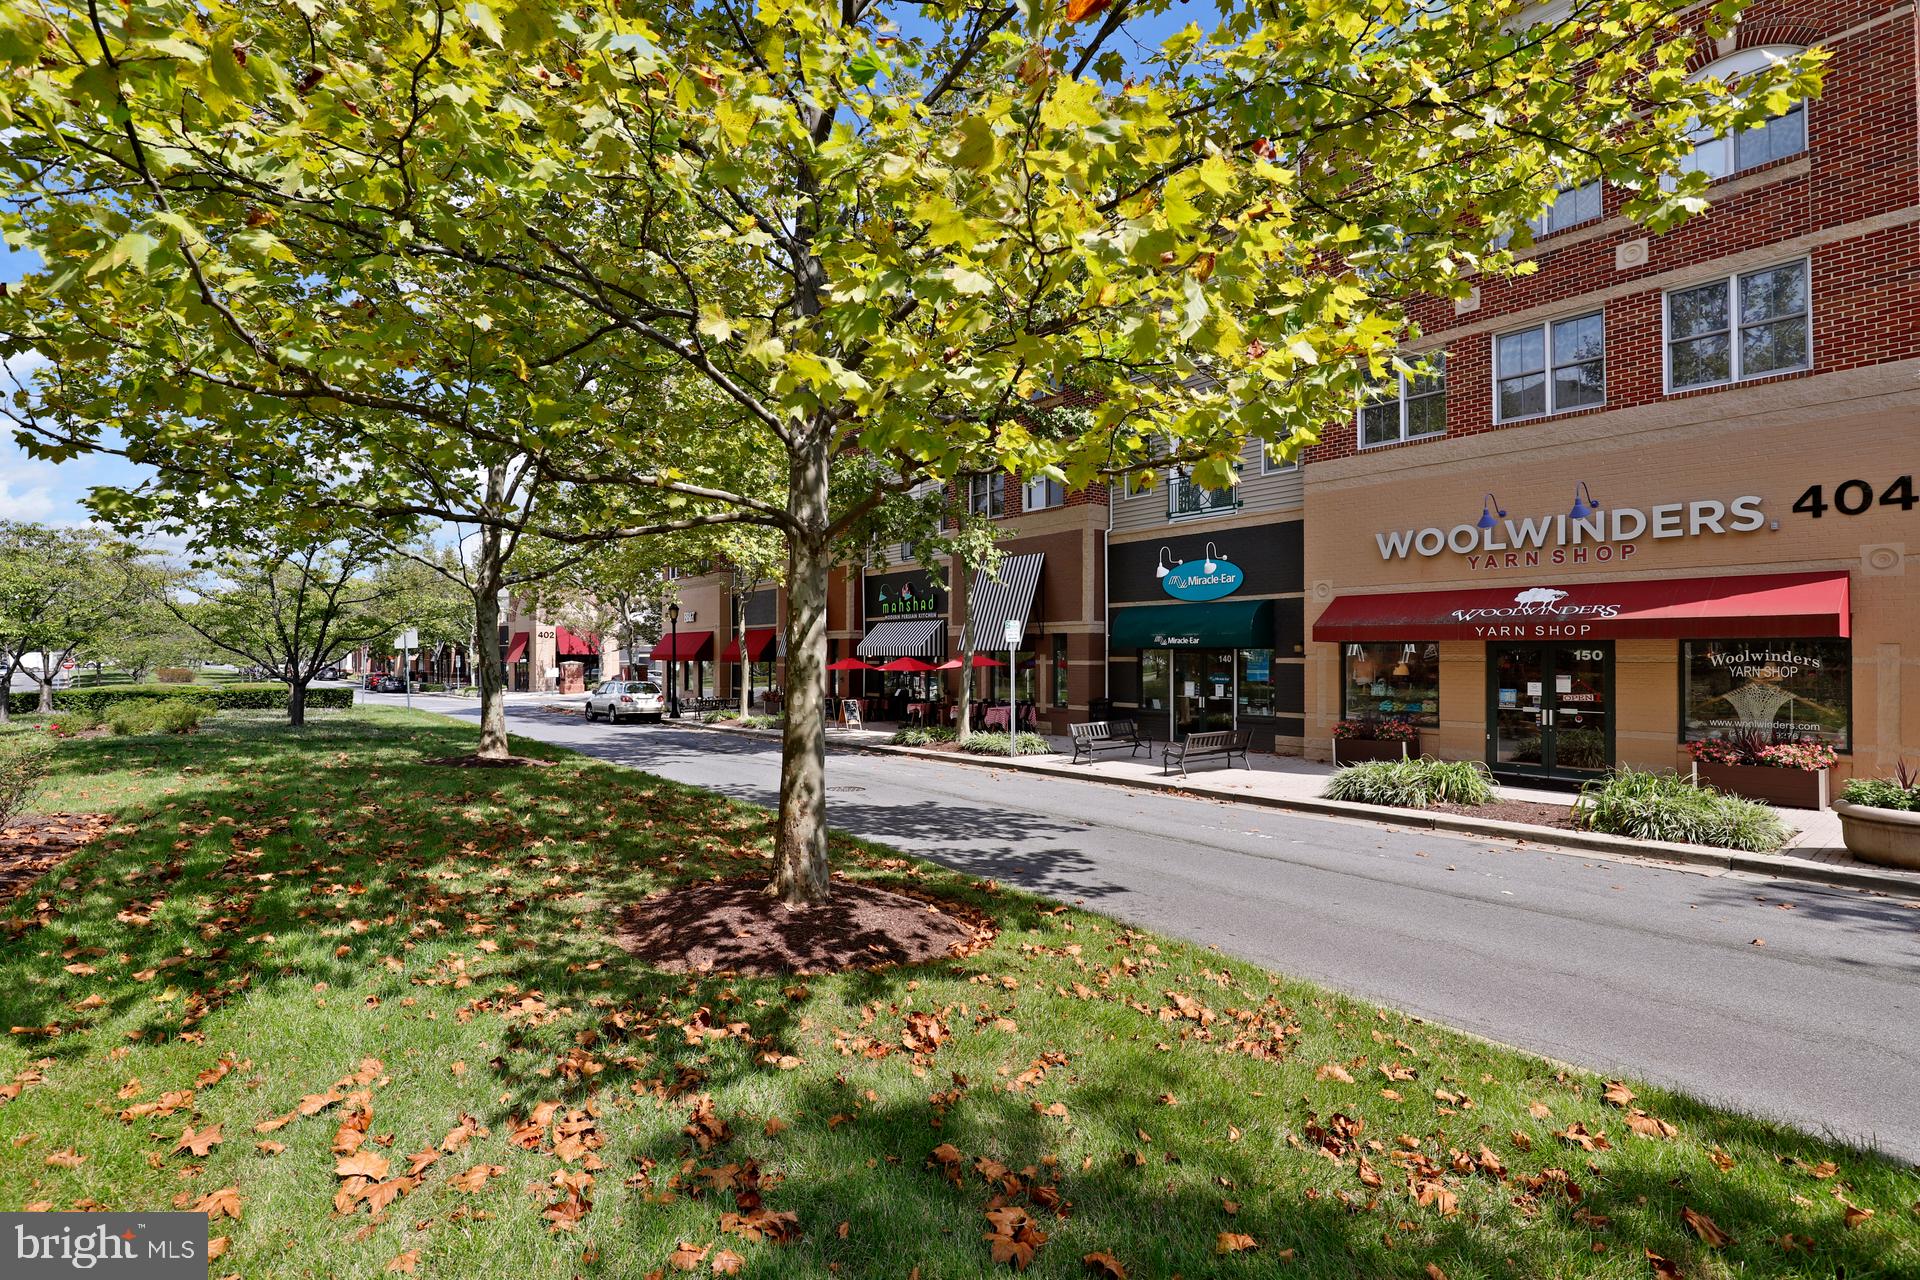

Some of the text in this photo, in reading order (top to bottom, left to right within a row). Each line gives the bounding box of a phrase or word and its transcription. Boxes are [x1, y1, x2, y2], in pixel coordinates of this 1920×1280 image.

[1792, 475, 1919, 518] 404
[1375, 496, 1765, 560] WOOLWINDERS
[1467, 544, 1636, 570] YARN SHOP
[1188, 574, 1236, 586] Miracle-Ear
[538, 631, 555, 639] 402
[1475, 625, 1591, 636] YARN SHOP
[1219, 655, 1232, 663] 140
[1574, 650, 1603, 660] 150
[1710, 649, 1821, 668] Woolwinders
[1729, 665, 1798, 678] YARN SHOP
